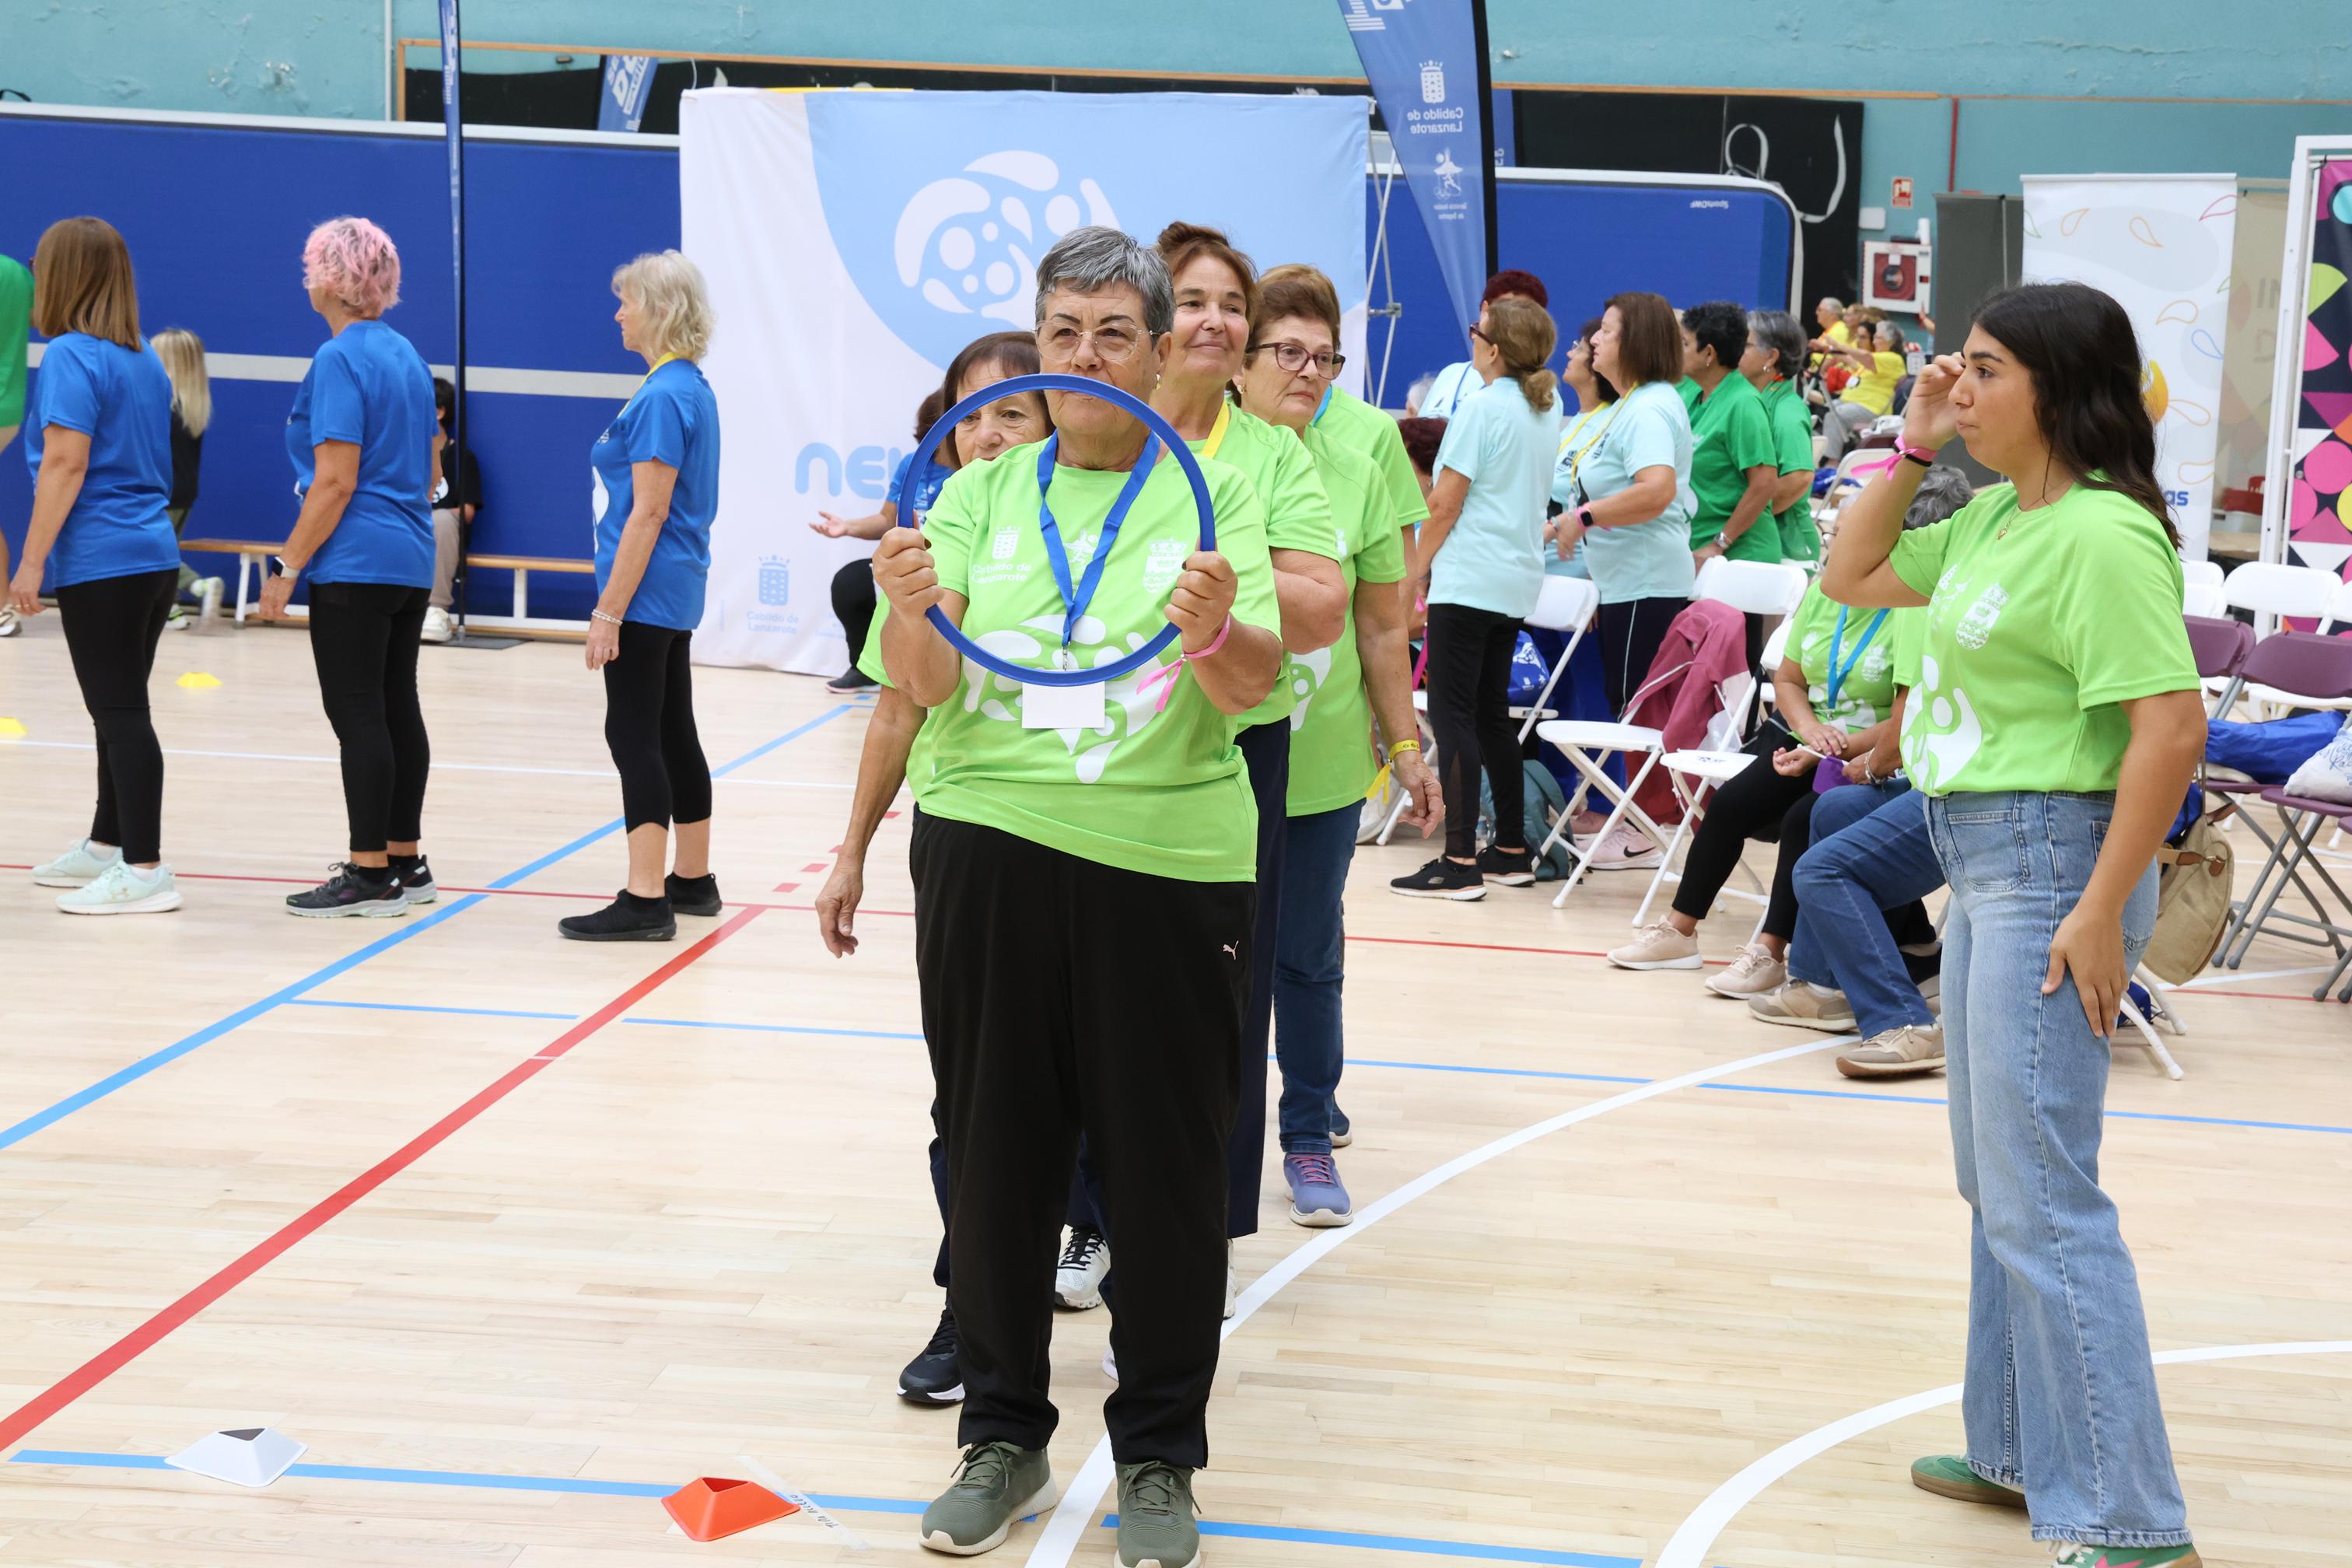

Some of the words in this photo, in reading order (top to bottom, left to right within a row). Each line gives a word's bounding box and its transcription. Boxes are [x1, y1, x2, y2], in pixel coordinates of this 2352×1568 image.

[747, 610, 784, 622] Cabildo
[787, 614, 800, 624] de
[748, 622, 797, 635] Lanzarote
